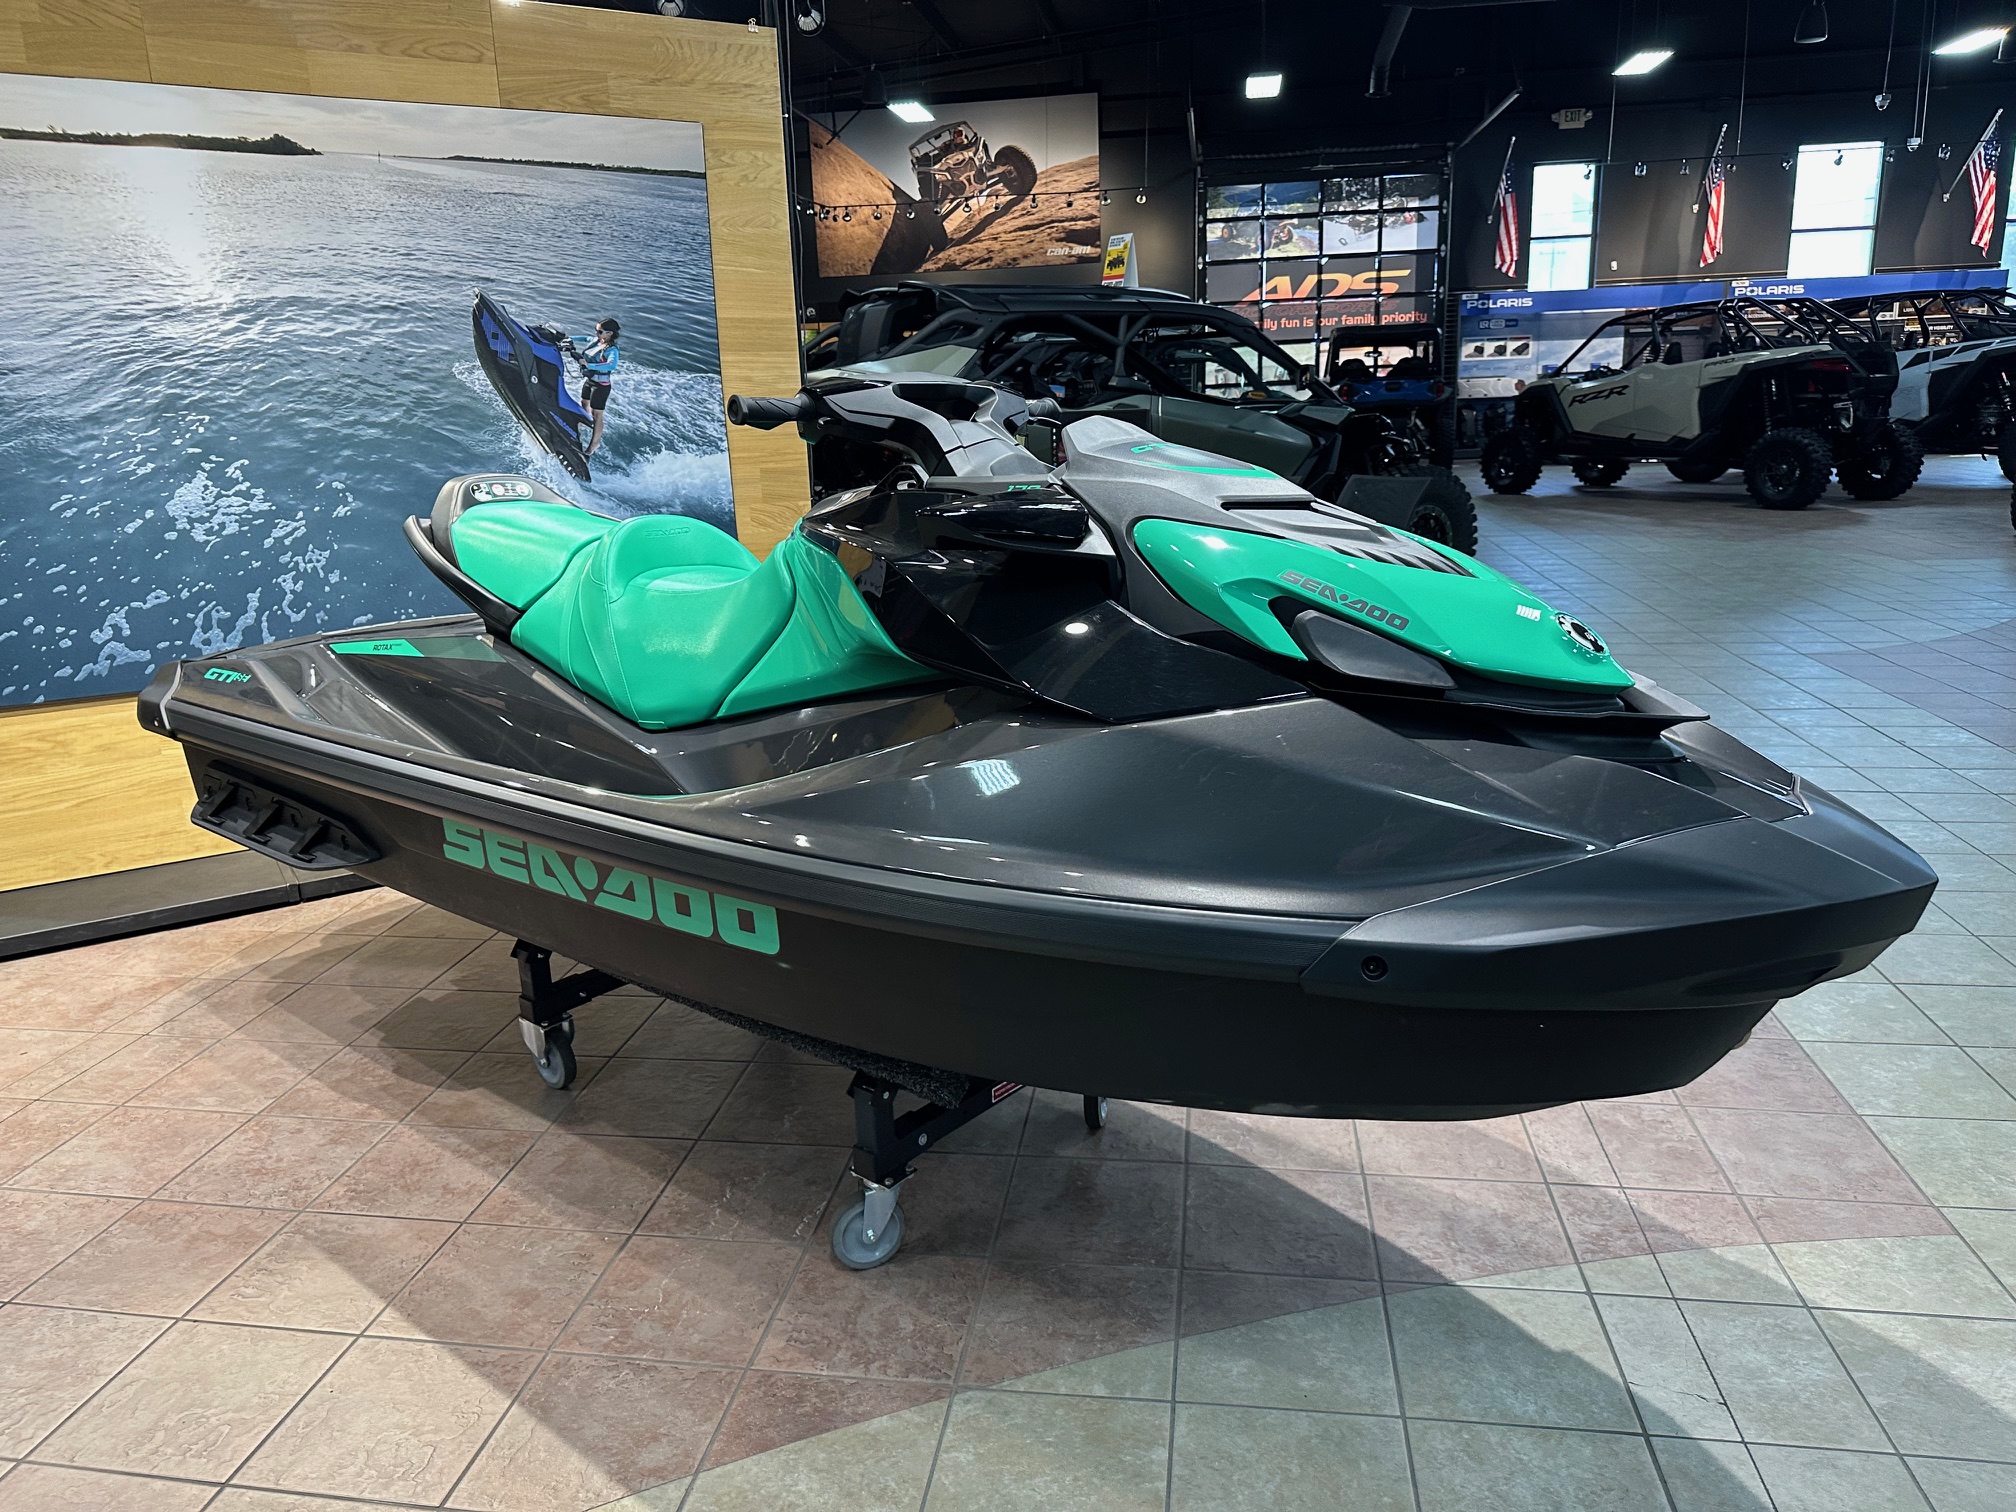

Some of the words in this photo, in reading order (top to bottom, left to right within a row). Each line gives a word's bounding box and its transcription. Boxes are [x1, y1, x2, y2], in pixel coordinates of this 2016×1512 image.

[1565, 110, 1580, 122] EXIT
[1734, 284, 1805, 296] POLARIS
[1466, 297, 1533, 309] POLARIS
[1280, 317, 1300, 328] fun
[1303, 316, 1314, 327] is
[1318, 317, 1339, 326] our
[1341, 313, 1376, 327] family
[1381, 311, 1427, 324] priority
[1568, 385, 1630, 408] RZR
